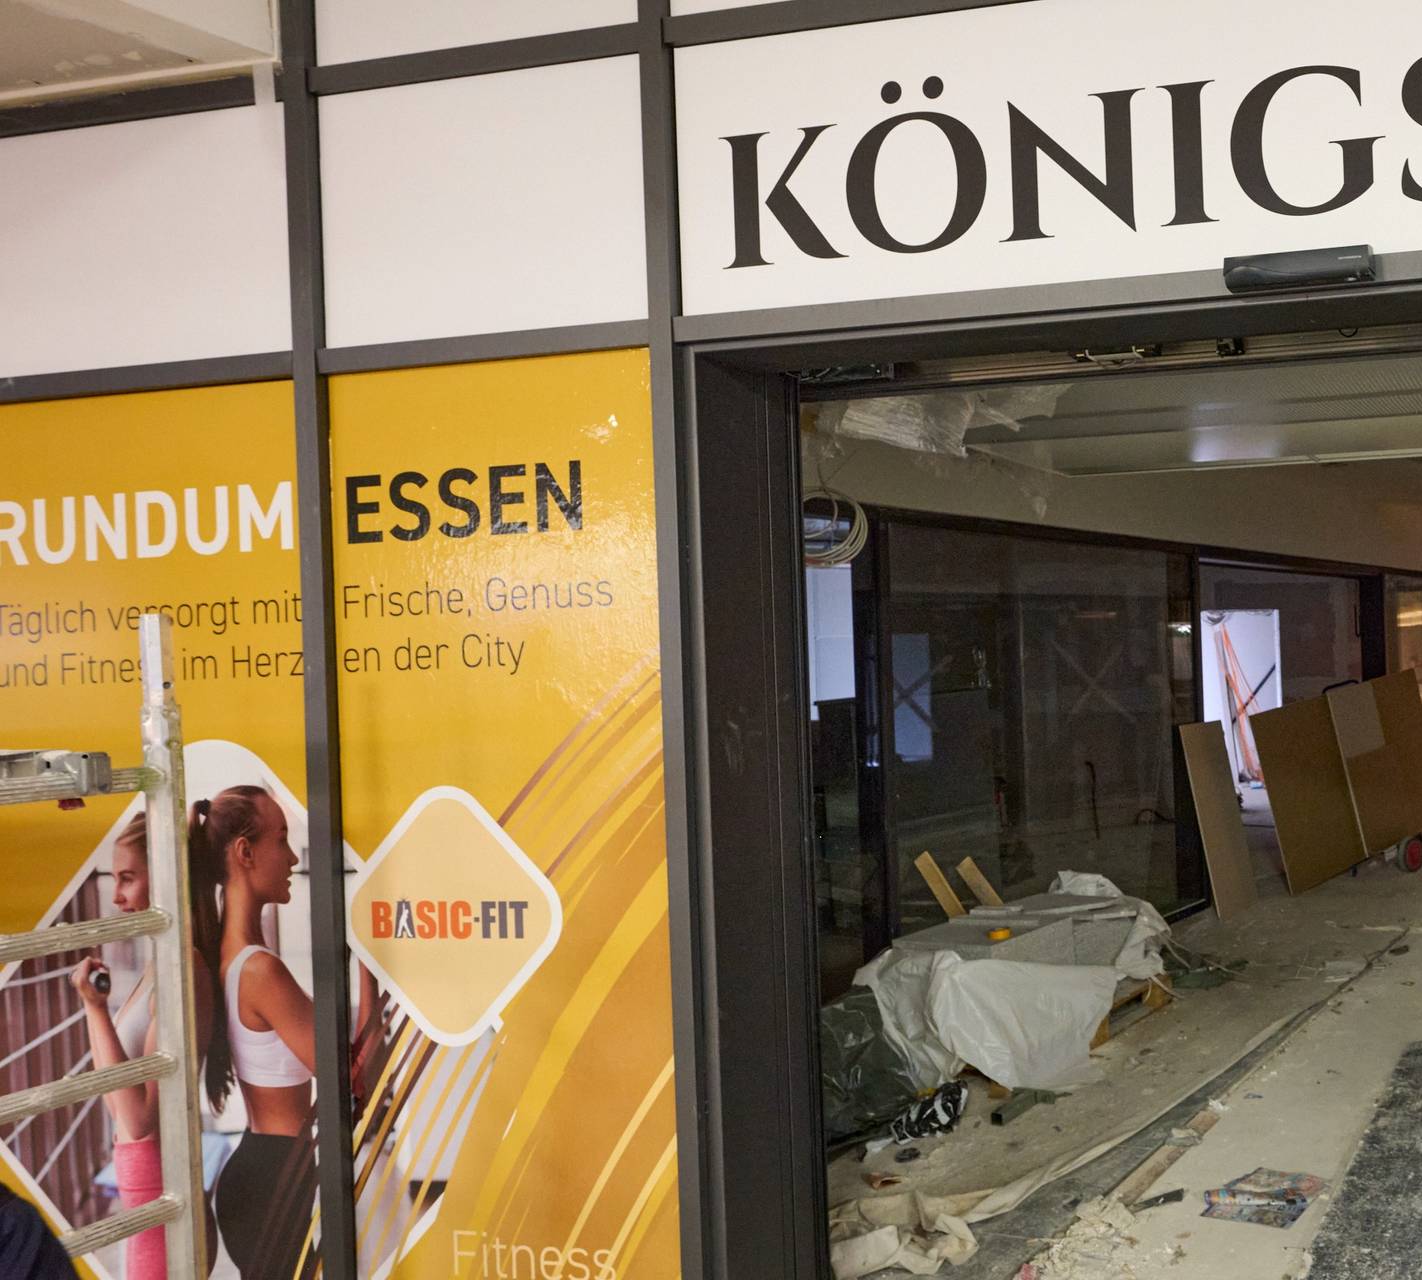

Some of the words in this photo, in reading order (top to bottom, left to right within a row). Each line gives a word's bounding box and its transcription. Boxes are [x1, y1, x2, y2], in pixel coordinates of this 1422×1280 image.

[0, 481, 294, 566] RUNDUM
[345, 460, 583, 544] ESSEN
[252, 590, 302, 624] mit
[343, 581, 472, 619] Frische,
[486, 577, 614, 612] Genuss
[61, 652, 144, 686] Fitne
[182, 648, 218, 681] im
[232, 646, 304, 678] Herz
[394, 637, 449, 671] der
[462, 633, 525, 675] City
[453, 1230, 617, 1280] Fitness
